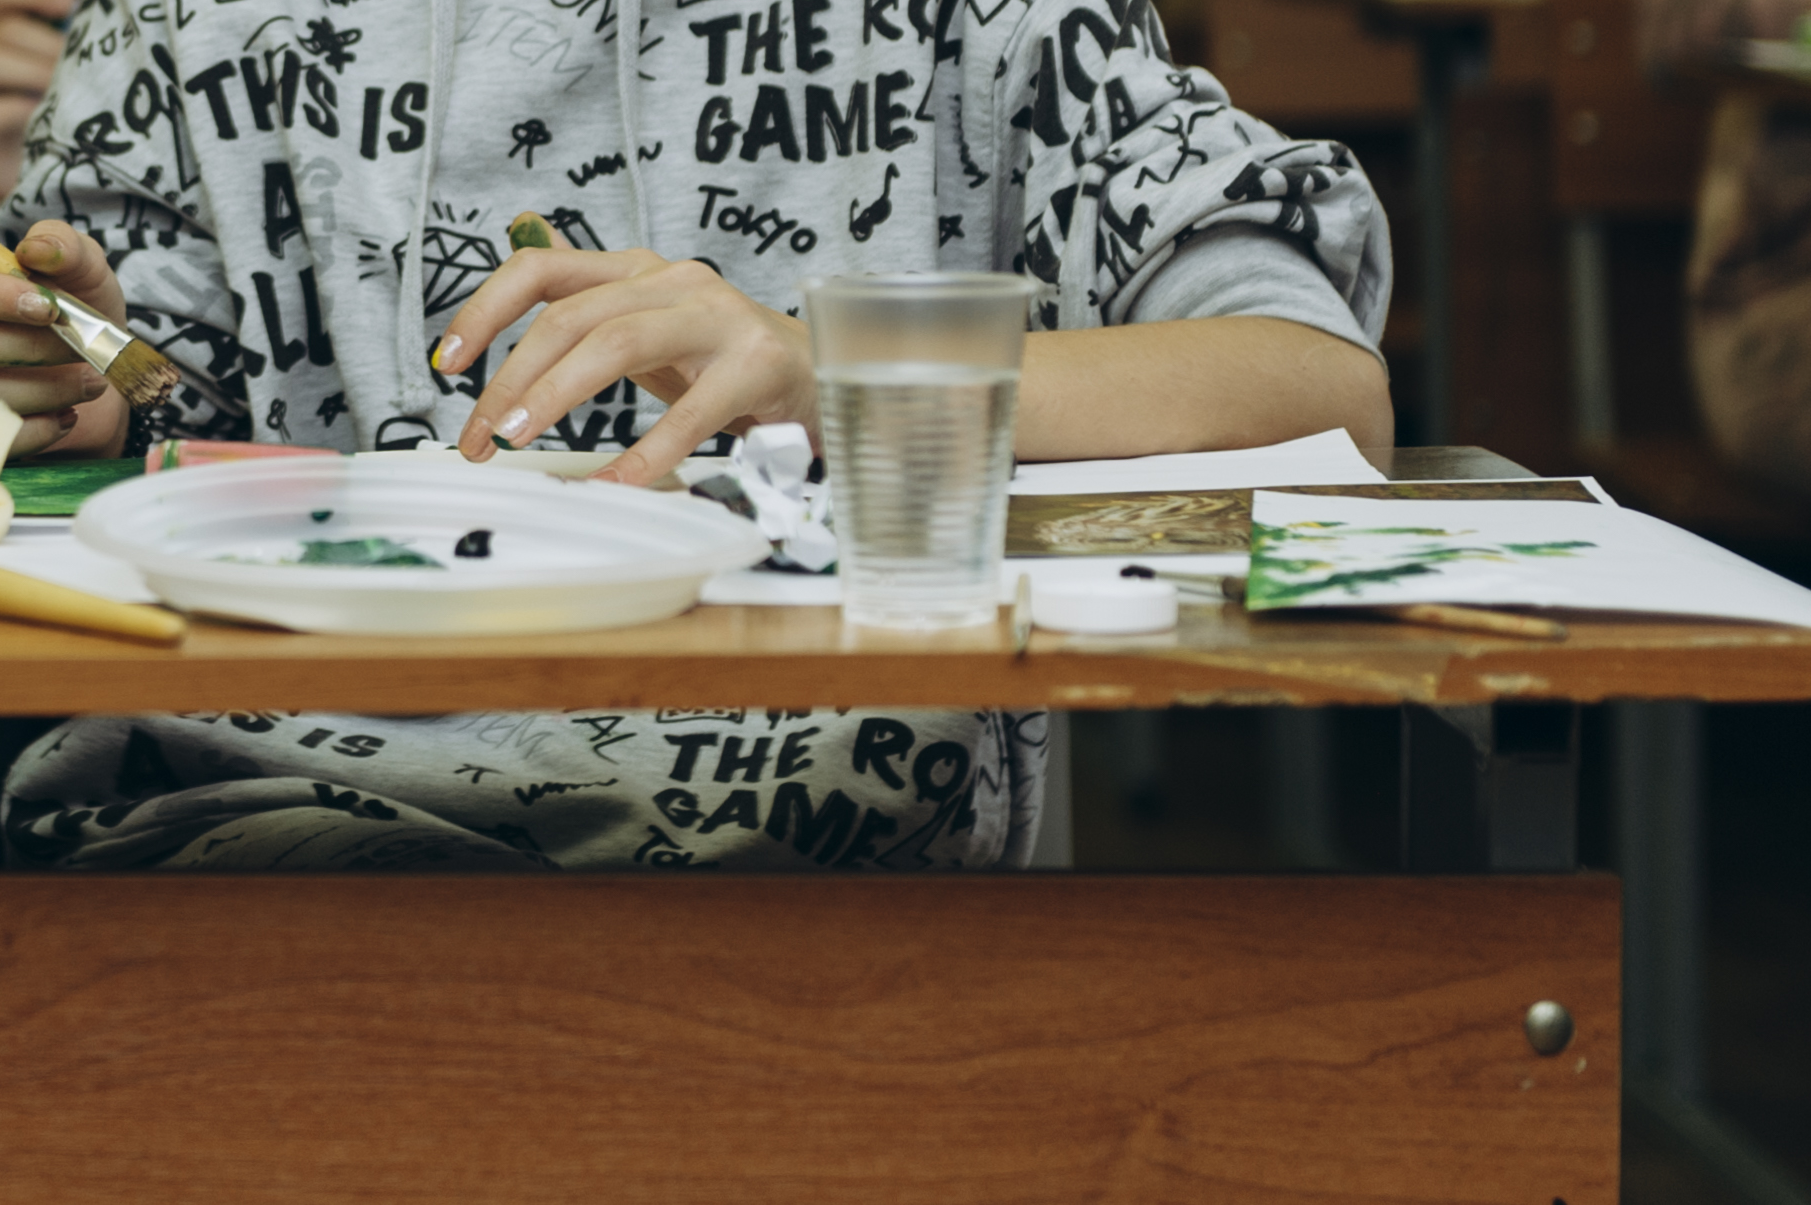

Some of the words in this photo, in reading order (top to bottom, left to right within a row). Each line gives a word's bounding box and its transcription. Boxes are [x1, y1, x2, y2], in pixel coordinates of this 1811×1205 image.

[359, 80, 430, 161] IS
[694, 69, 919, 165] GAME
[296, 727, 388, 759] IS
[663, 726, 822, 784] THE
